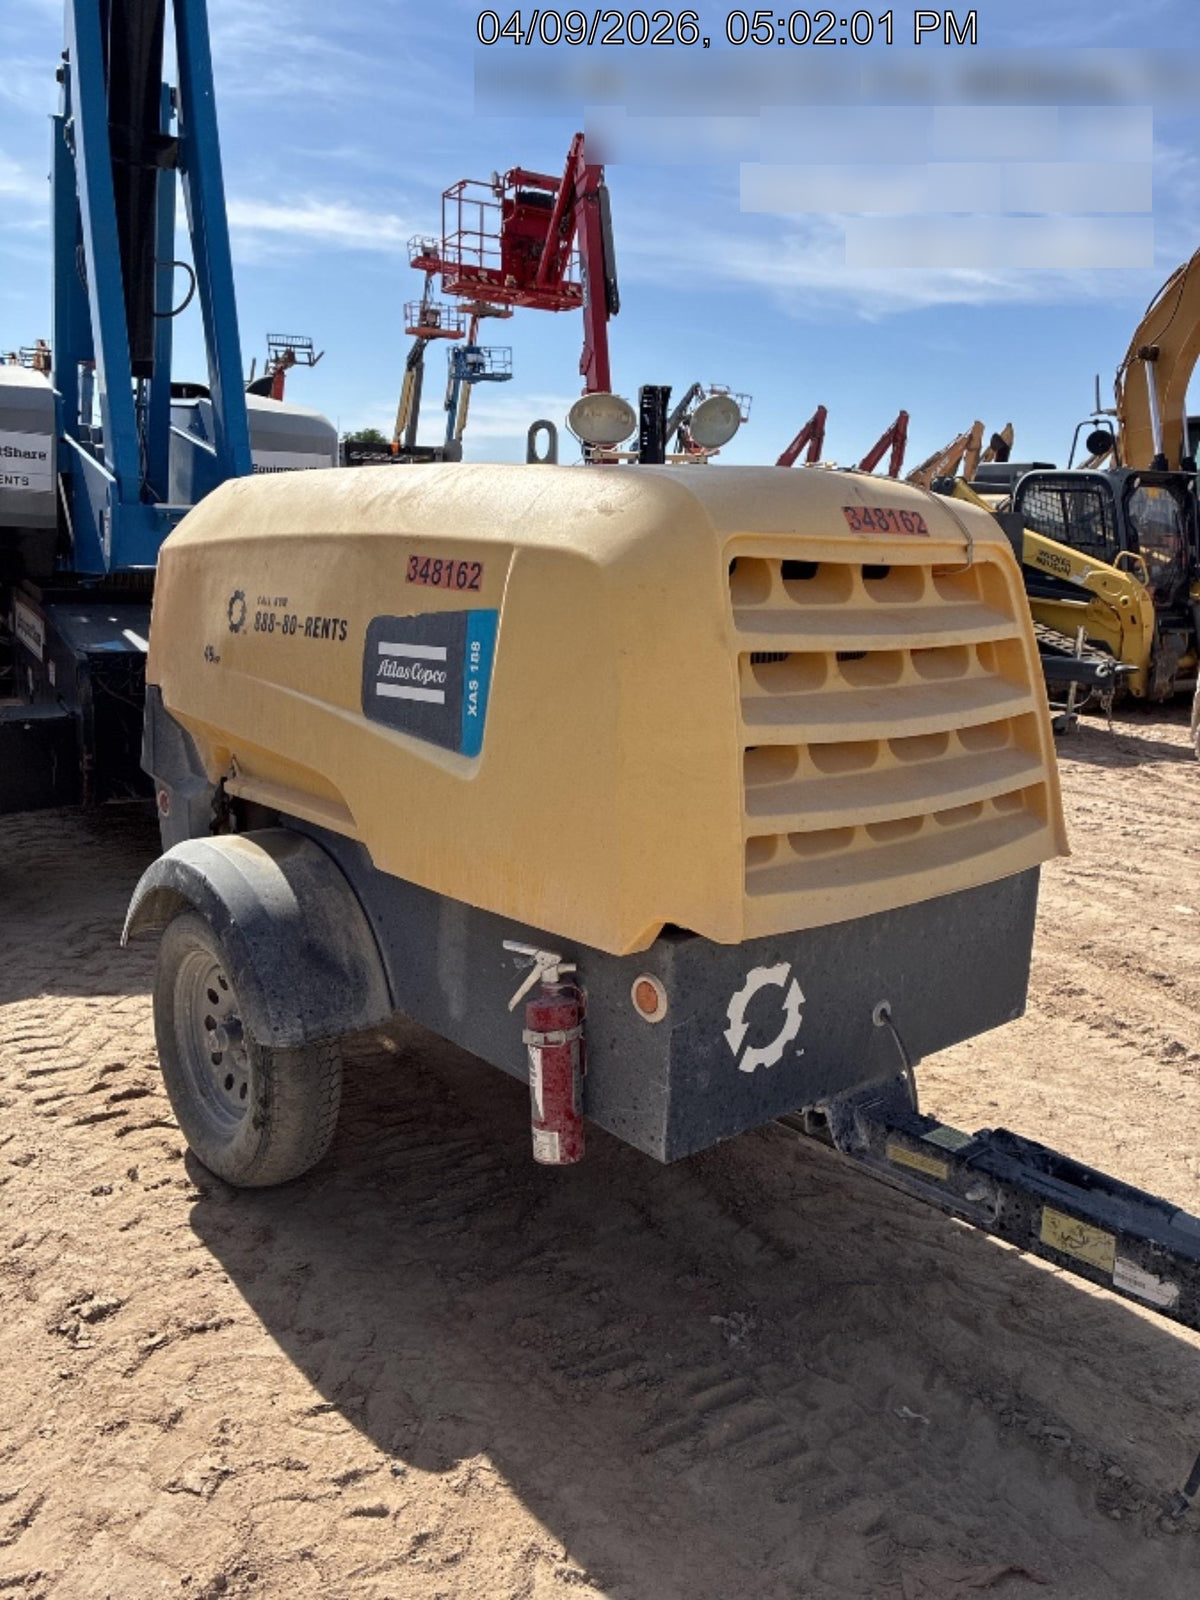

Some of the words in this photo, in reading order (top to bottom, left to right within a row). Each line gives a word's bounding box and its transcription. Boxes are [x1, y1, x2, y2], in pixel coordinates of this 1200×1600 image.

[842, 506, 929, 534] 348162
[408, 555, 482, 589] 348162
[254, 611, 348, 641] 888-80-RENTS
[376, 659, 410, 680] Atlas
[411, 663, 447, 686] Copco
[470, 641, 481, 673] 188
[467, 680, 479, 717] XAS
